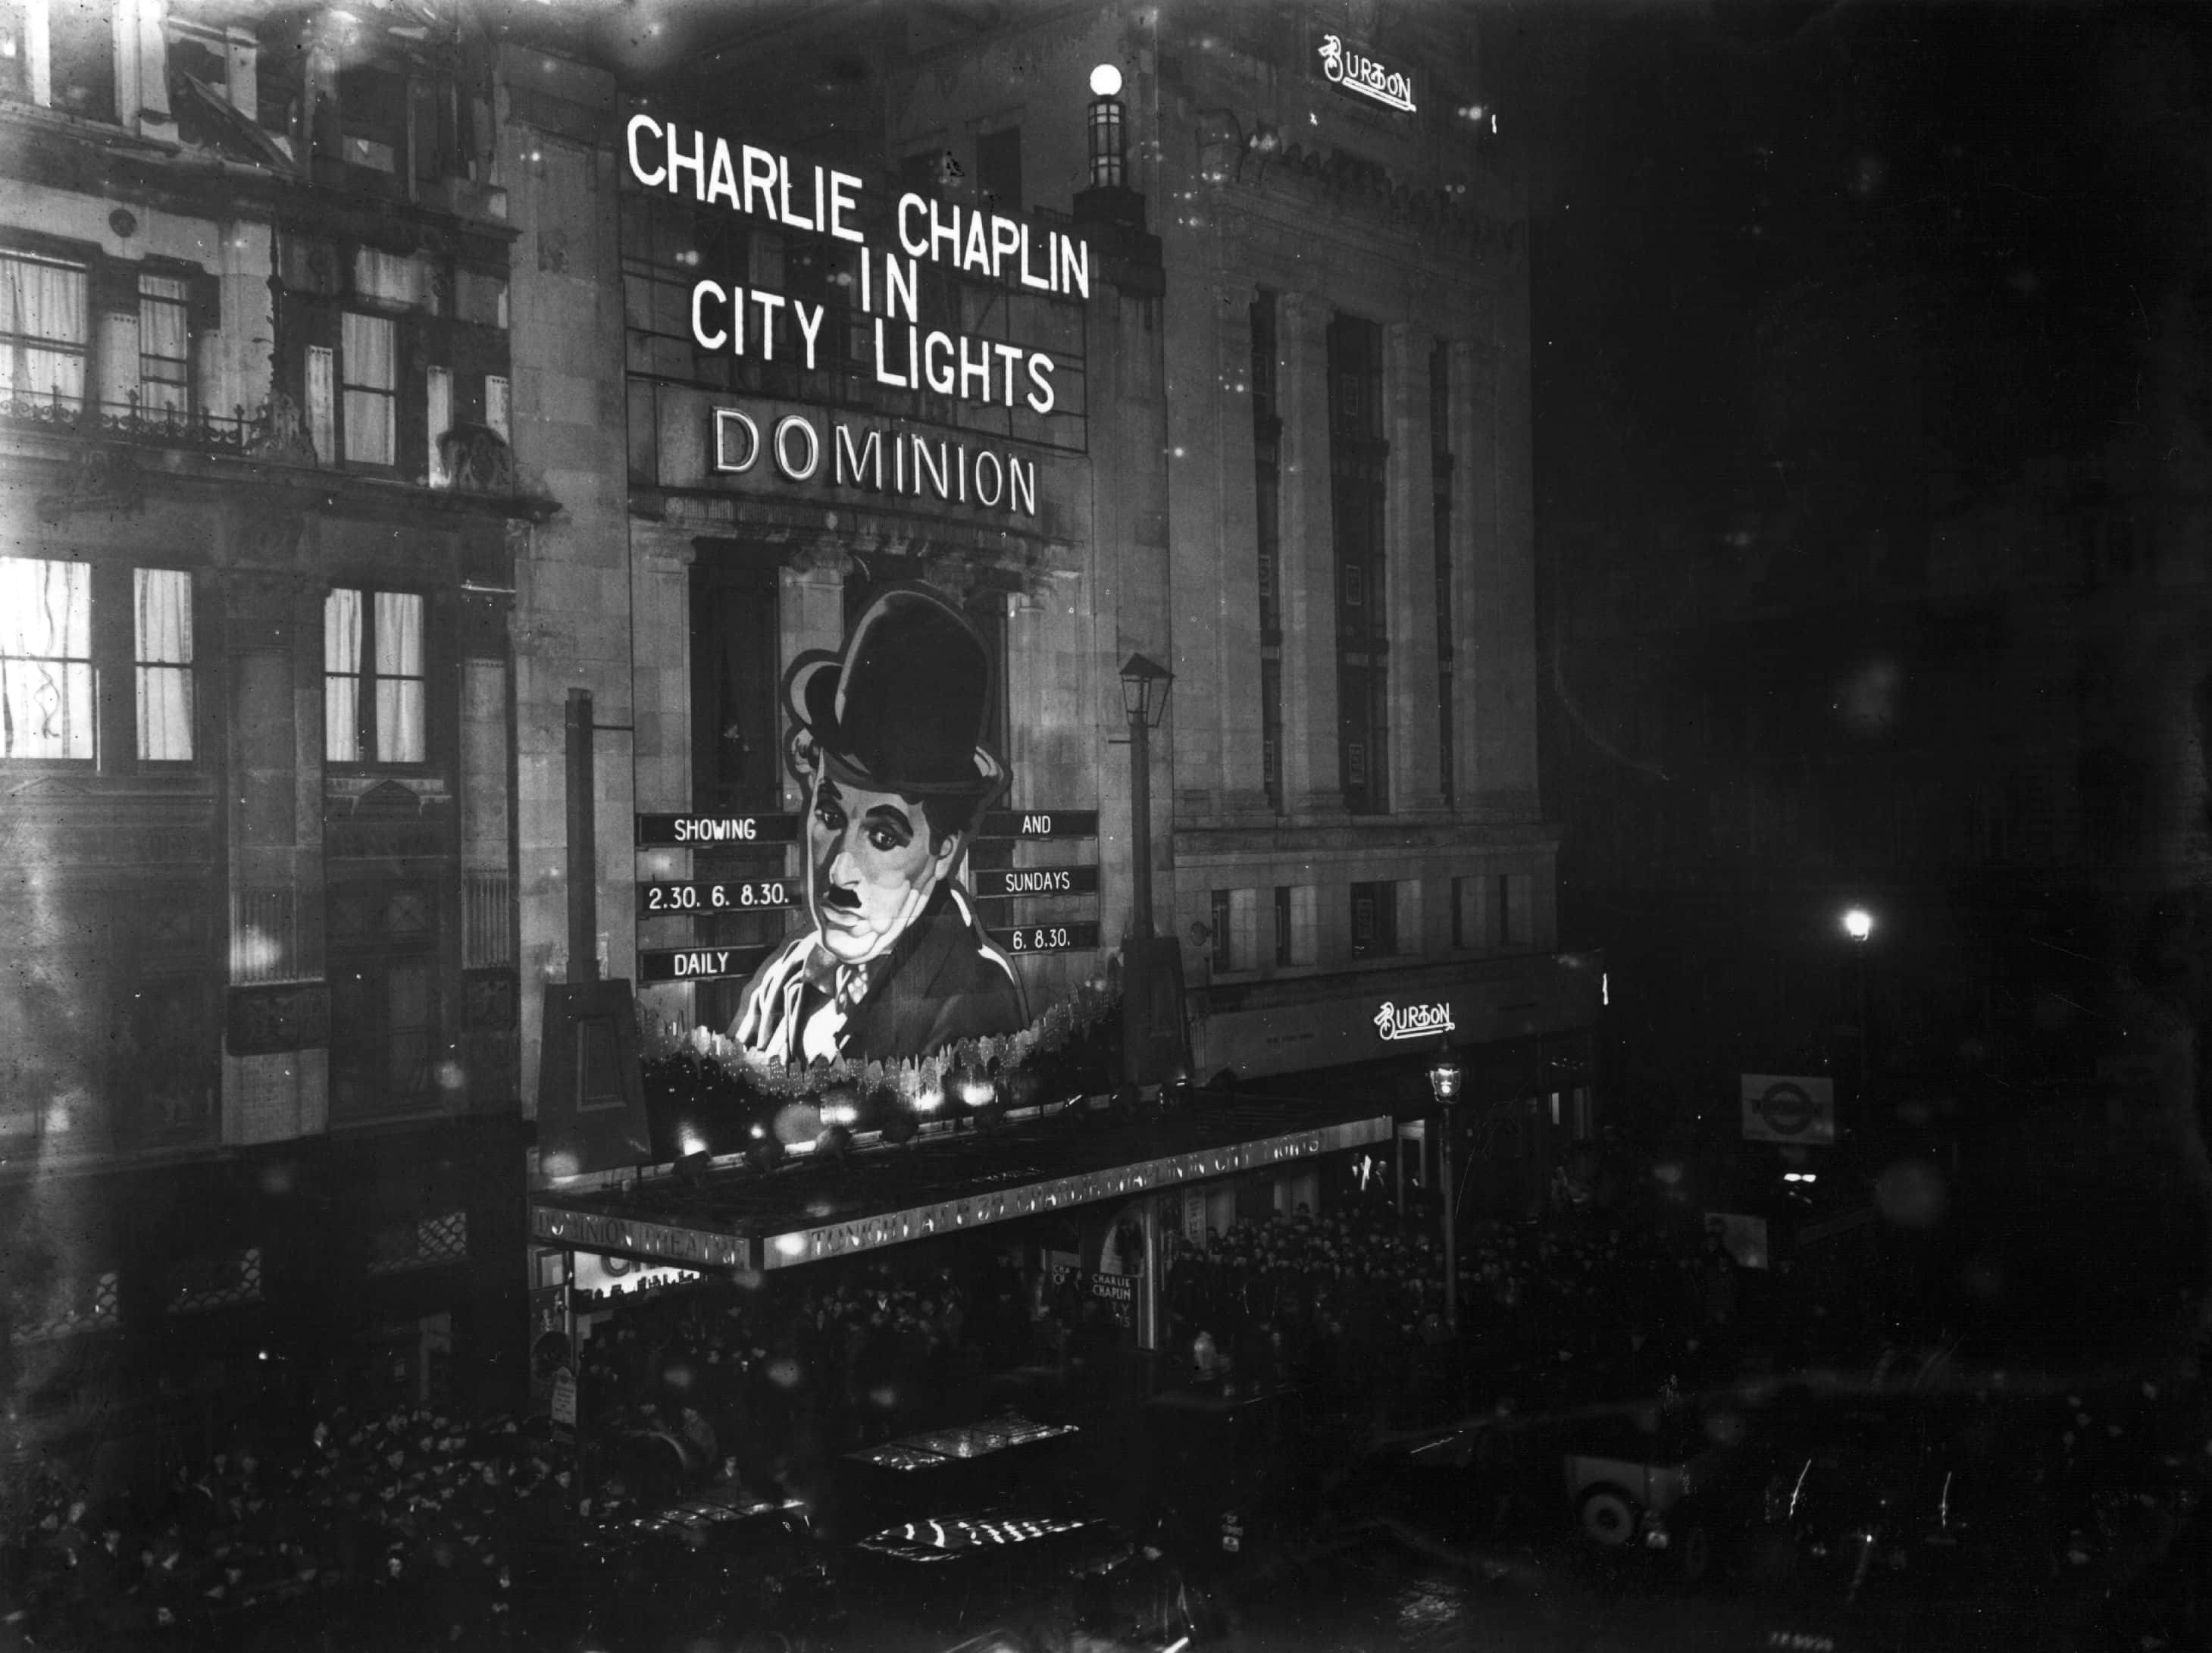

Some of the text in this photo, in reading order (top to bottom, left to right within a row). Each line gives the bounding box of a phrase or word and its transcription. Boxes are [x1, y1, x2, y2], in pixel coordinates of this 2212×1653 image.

[1319, 34, 1412, 105] BURTON
[626, 114, 1090, 299] CHARLIE CHAPLIN
[860, 246, 918, 324] IN
[691, 279, 1055, 414] CITY LIGHTS
[712, 406, 1036, 517] DOMINION
[674, 818, 757, 841] SHOWING
[1021, 815, 1052, 834] AND
[1005, 871, 1071, 893] SUNDAYS
[648, 882, 790, 910] 2.30. 6. 8.30.
[1012, 928, 1071, 950] 6. 8.30.
[674, 950, 729, 976] DAILY
[1373, 1000, 1450, 1041] BURTON
[1092, 1273, 1131, 1288] CHARLIE
[1092, 1285, 1131, 1301] CHAPLIN
